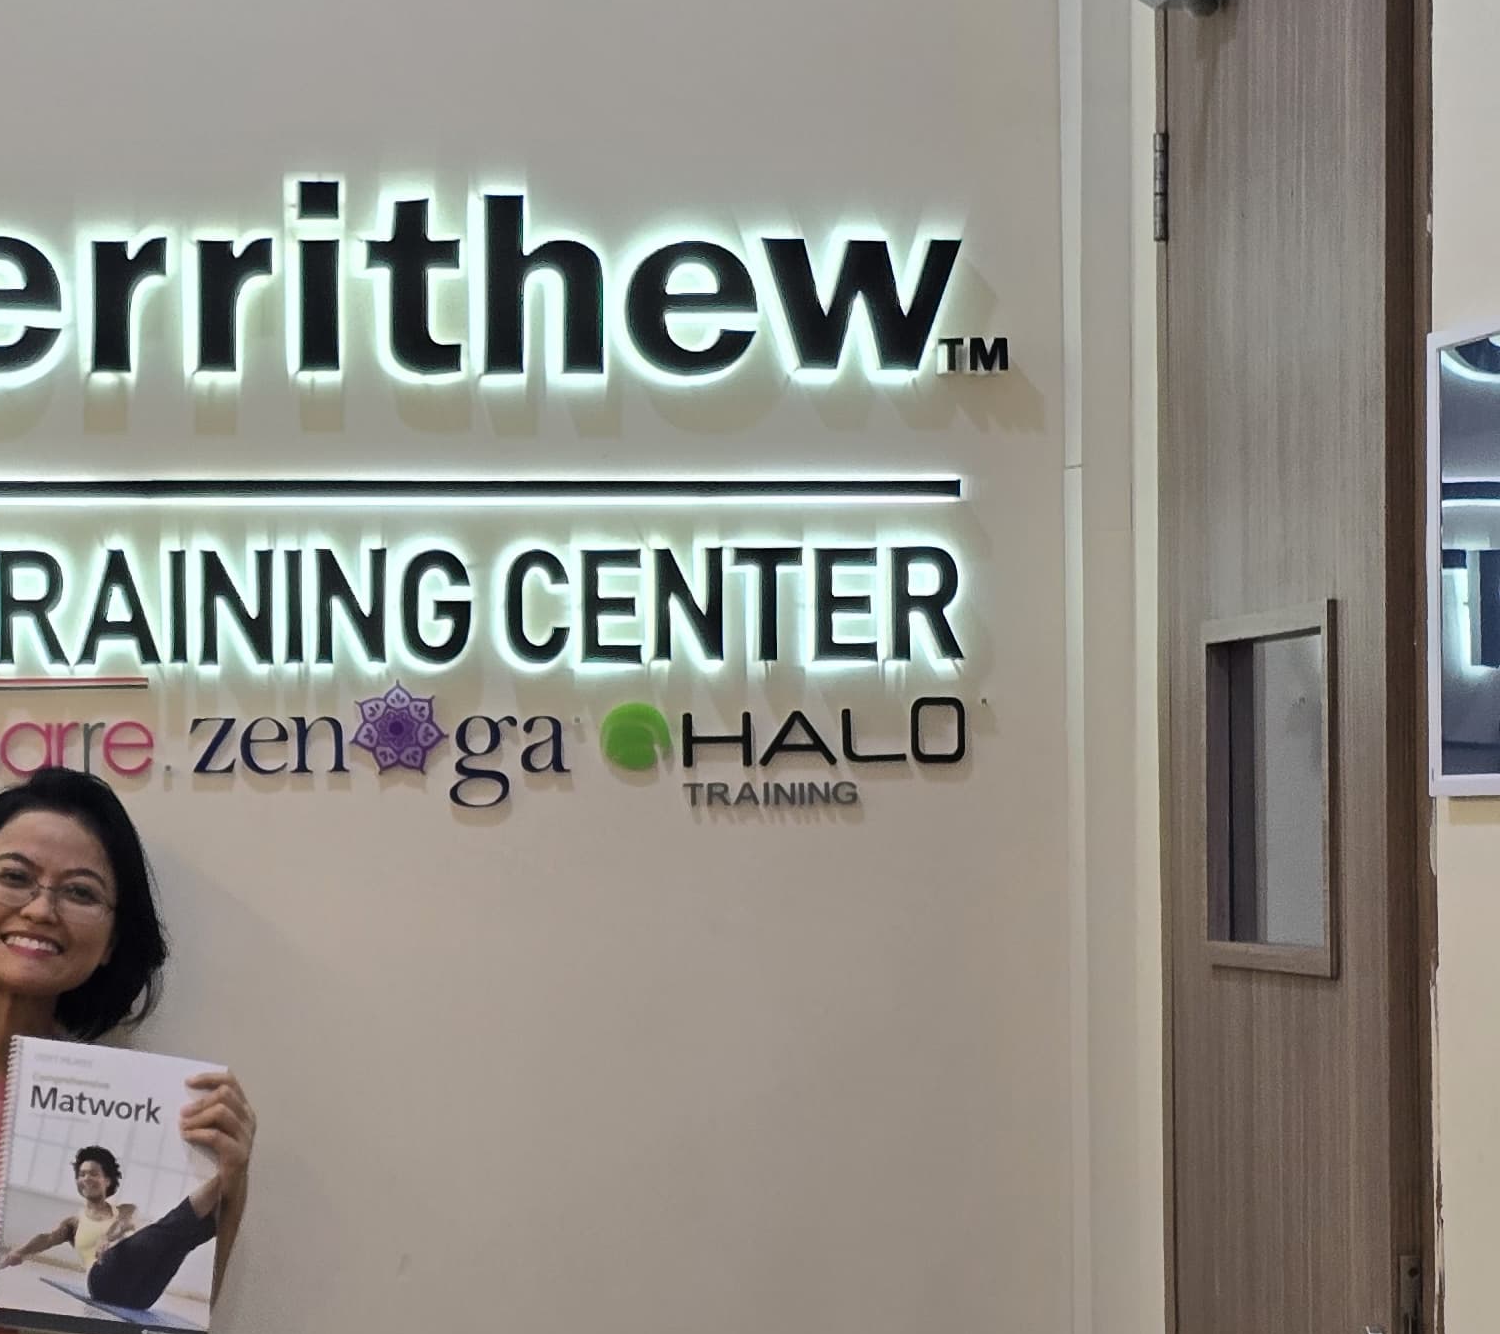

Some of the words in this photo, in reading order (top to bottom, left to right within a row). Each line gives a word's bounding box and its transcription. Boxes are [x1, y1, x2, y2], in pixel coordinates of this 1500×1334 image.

[504, 546, 964, 665] CENTER
[682, 696, 966, 768] HALO
[683, 781, 858, 807] TRAINING
[29, 1084, 162, 1125] Matwork
